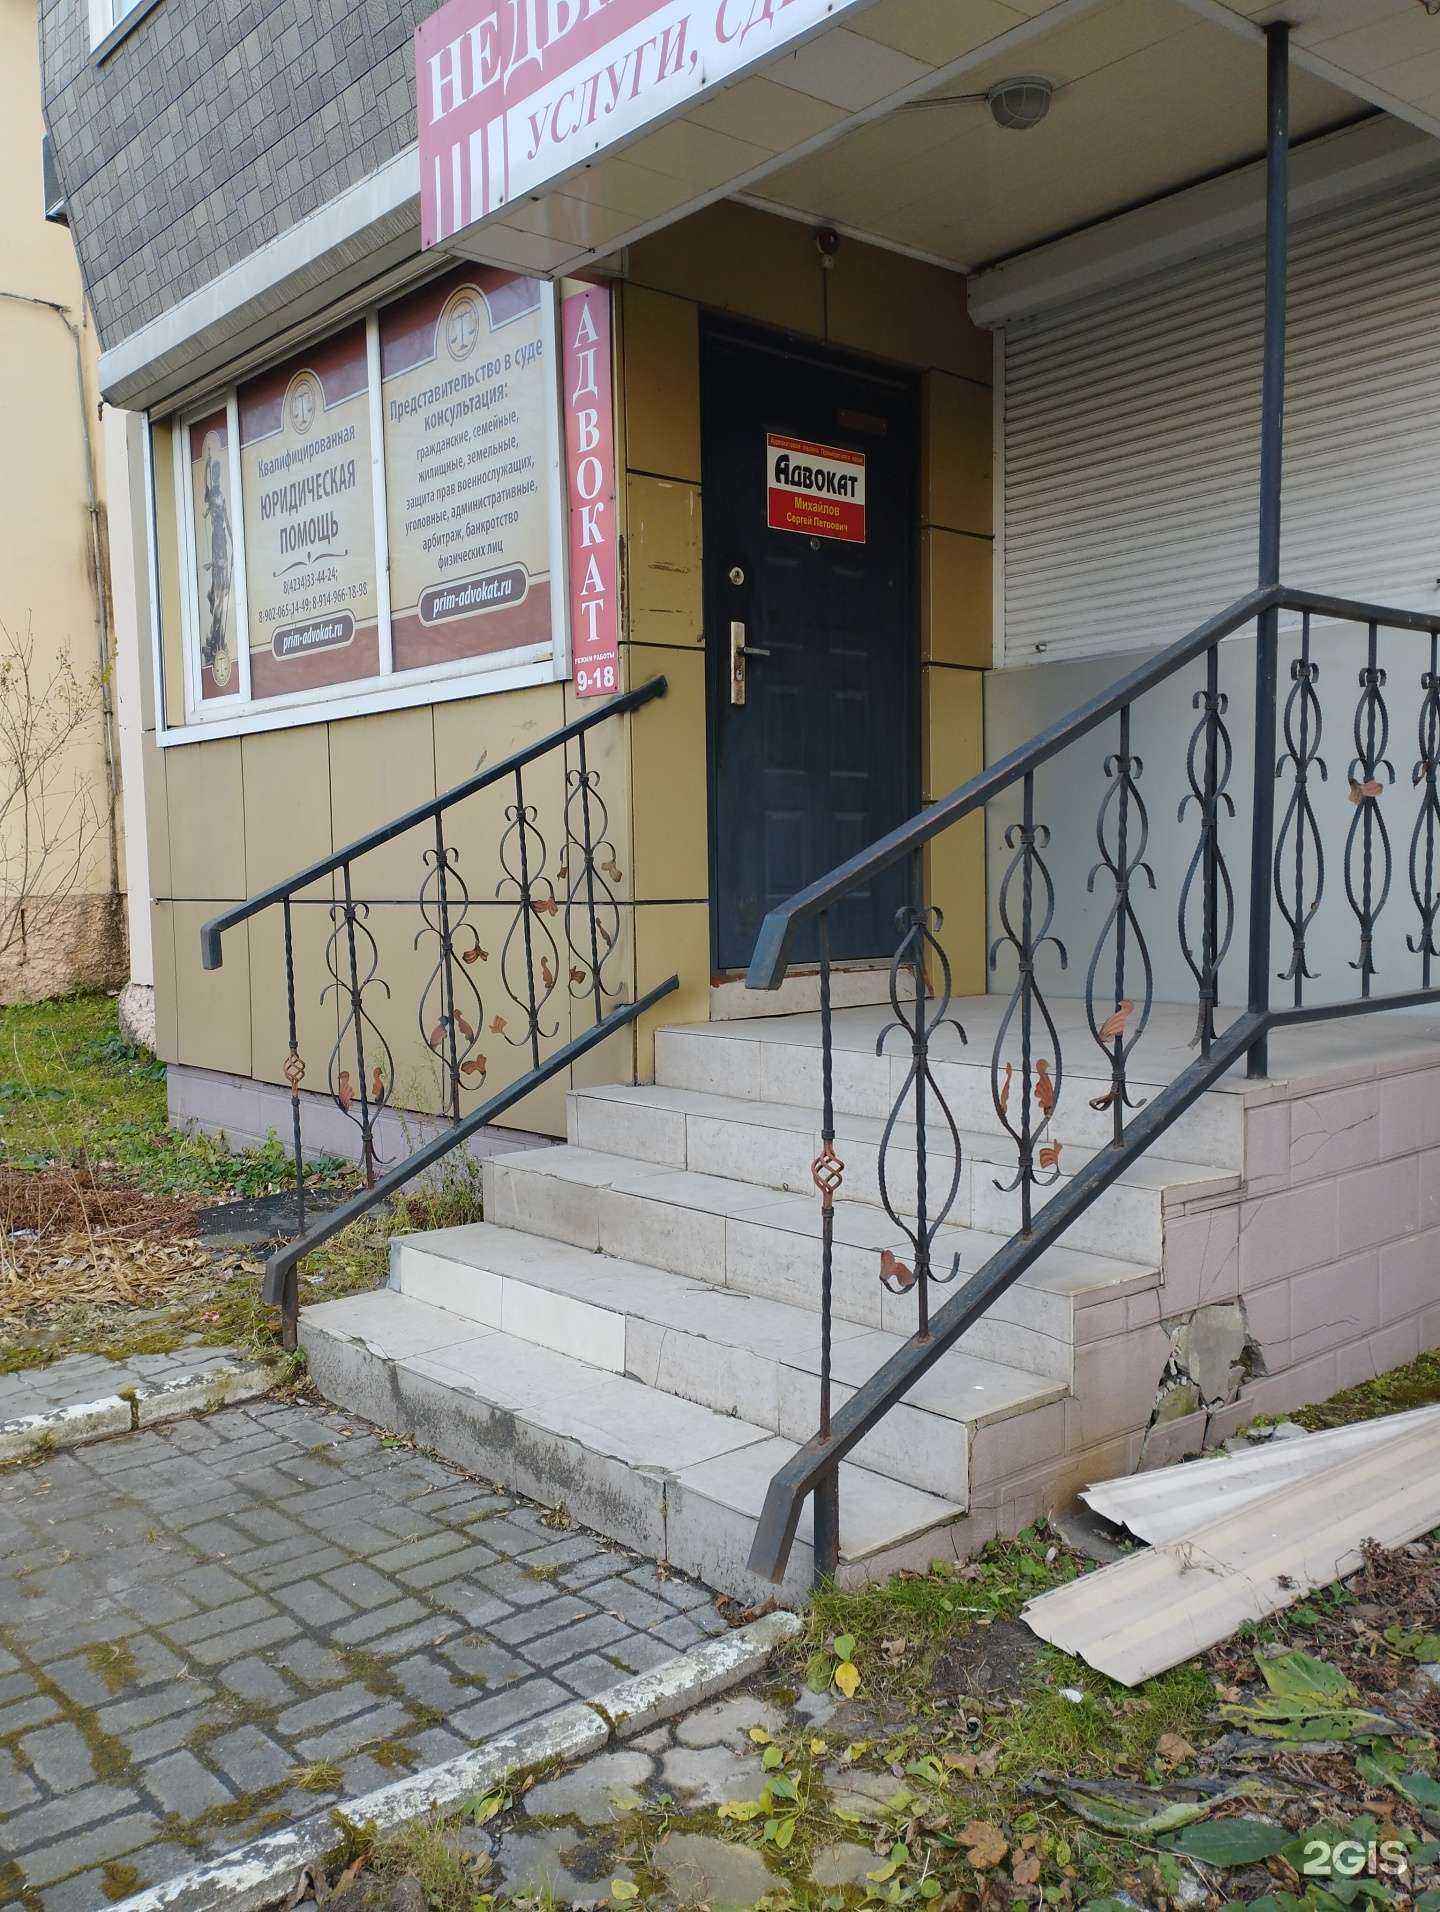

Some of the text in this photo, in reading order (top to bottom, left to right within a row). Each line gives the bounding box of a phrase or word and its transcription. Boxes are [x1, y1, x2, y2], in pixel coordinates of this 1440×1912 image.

[527, 14, 699, 160] УСЛУГИ,
[389, 338, 543, 424] Представительство в суде
[424, 382, 509, 431] консультация:
[258, 425, 356, 478] Квалифицированная
[416, 410, 519, 462] гражданские, семейные,
[418, 434, 519, 483] жилищные, земельные,
[260, 459, 356, 520] ЮРИДИЧЕСКАЯ
[406, 455, 535, 511] защита прав военнослужащих,
[573, 302, 605, 642] АДВОКАТ
[405, 480, 538, 536] уголовные, административные,
[786, 511, 848, 533] Сергей Петрович
[794, 496, 841, 516] Михайлов
[280, 511, 339, 554] ПОМОЩЬ
[422, 510, 519, 552] арбитраж, банкротство
[437, 540, 504, 572] физических лиц
[433, 578, 512, 617] prim-advokat.ru
[283, 623, 343, 654] prim-advokat.ru
[577, 666, 615, 692] 9-18
